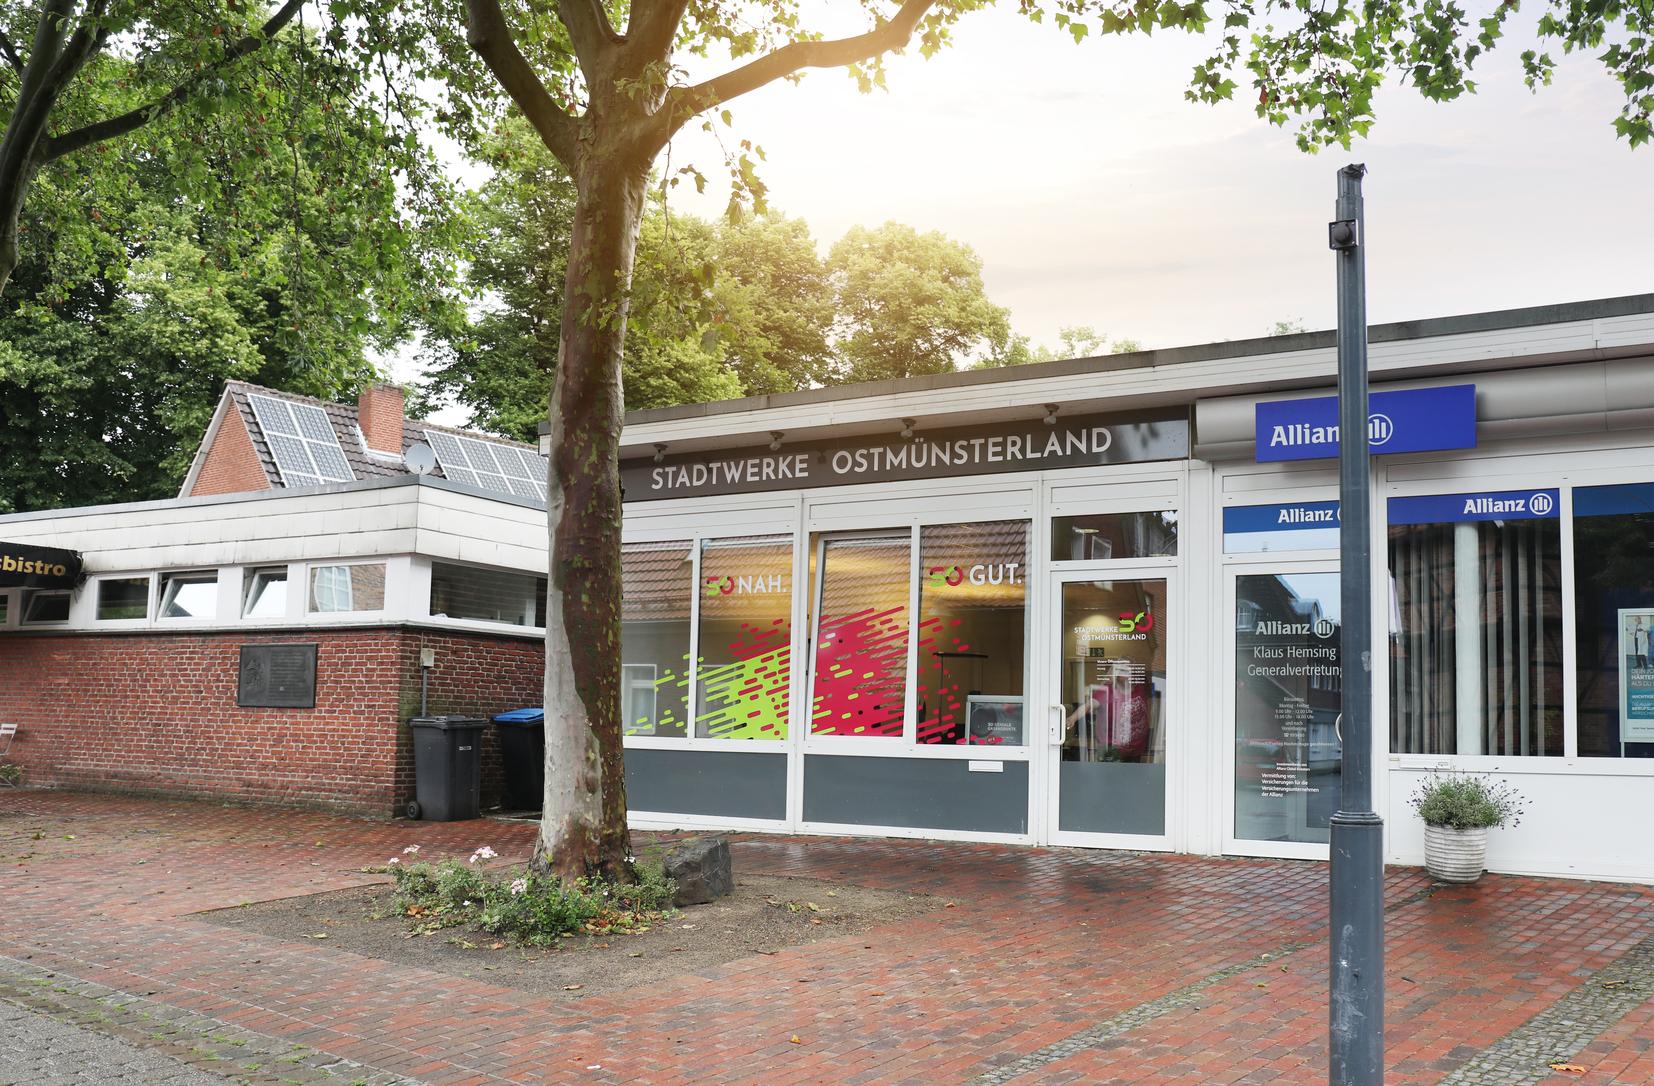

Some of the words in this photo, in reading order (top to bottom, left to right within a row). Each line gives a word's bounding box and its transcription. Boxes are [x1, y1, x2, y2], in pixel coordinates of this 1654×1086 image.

[1270, 423, 1340, 447] Allian
[651, 454, 809, 490] STADTWERKE
[832, 427, 1112, 474] OSTMÜNSTERLAND
[1464, 498, 1525, 514] Allianz
[1278, 508, 1333, 523] Allianz
[0, 555, 66, 577] bistro
[969, 563, 1022, 586] GUT.
[738, 574, 787, 594] NAH.
[1073, 626, 1118, 634] STADTWERKE
[1256, 621, 1310, 635] Allianz
[1254, 645, 1284, 658] Klaus
[1287, 645, 1336, 661] Hemsing
